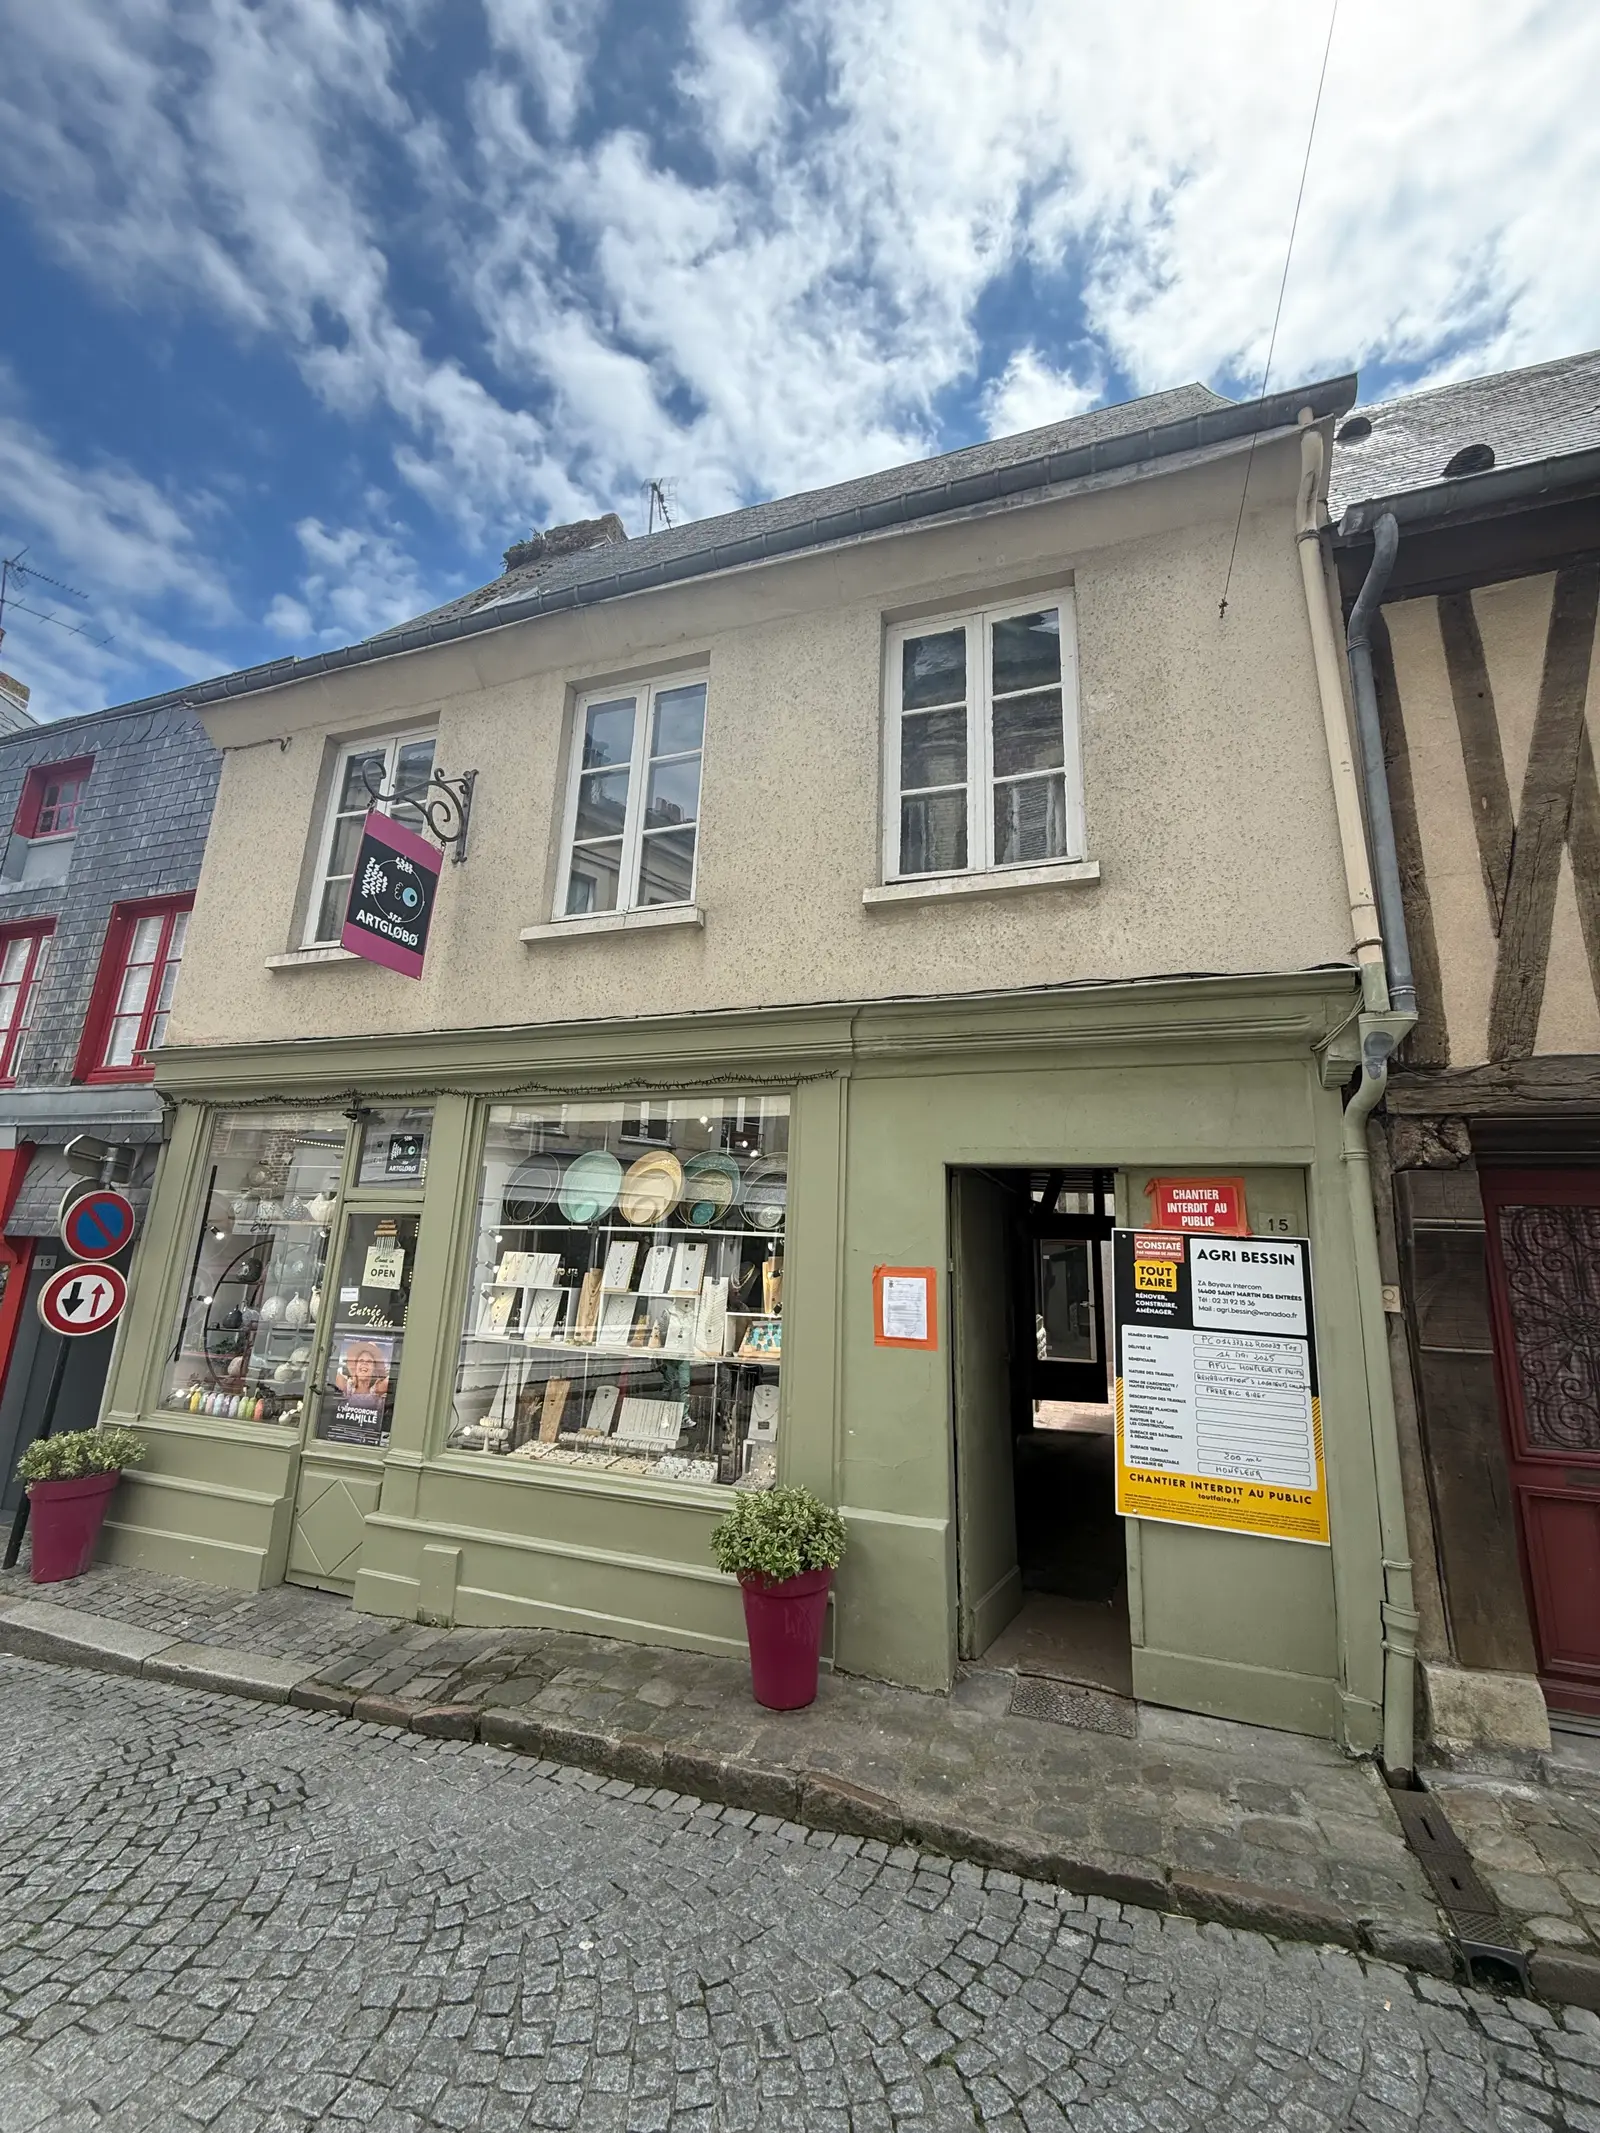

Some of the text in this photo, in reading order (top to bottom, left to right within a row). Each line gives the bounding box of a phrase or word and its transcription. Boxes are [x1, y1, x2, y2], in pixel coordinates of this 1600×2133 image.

[1172, 1189, 1219, 1200] CHANTIER
[1167, 1202, 1228, 1213] INTERDIT AU
[1181, 1216, 1215, 1227] PUBLIC
[1268, 1218, 1288, 1231] 15
[1136, 1241, 1181, 1250] CONSTATÉ
[1197, 1248, 1295, 1266] AGRI BESSIN
[41, 1259, 51, 1267] 13
[371, 1269, 395, 1278] OPEN
[1139, 1266, 1172, 1277] TOUT
[1140, 1277, 1172, 1288] FAIRE
[1208, 1281, 1231, 1289] Bayeux
[1233, 1282, 1262, 1290] Intercom
[348, 1303, 381, 1316] Entrée
[1135, 1300, 1178, 1309] CONSTRUIRE,
[365, 1315, 394, 1328] Libre
[345, 1413, 377, 1426] FAMILLE
[1130, 1473, 1312, 1505] CHANTIER INTERDIT AU PUBLIC
[1198, 1493, 1240, 1505] toutfaire.fr
